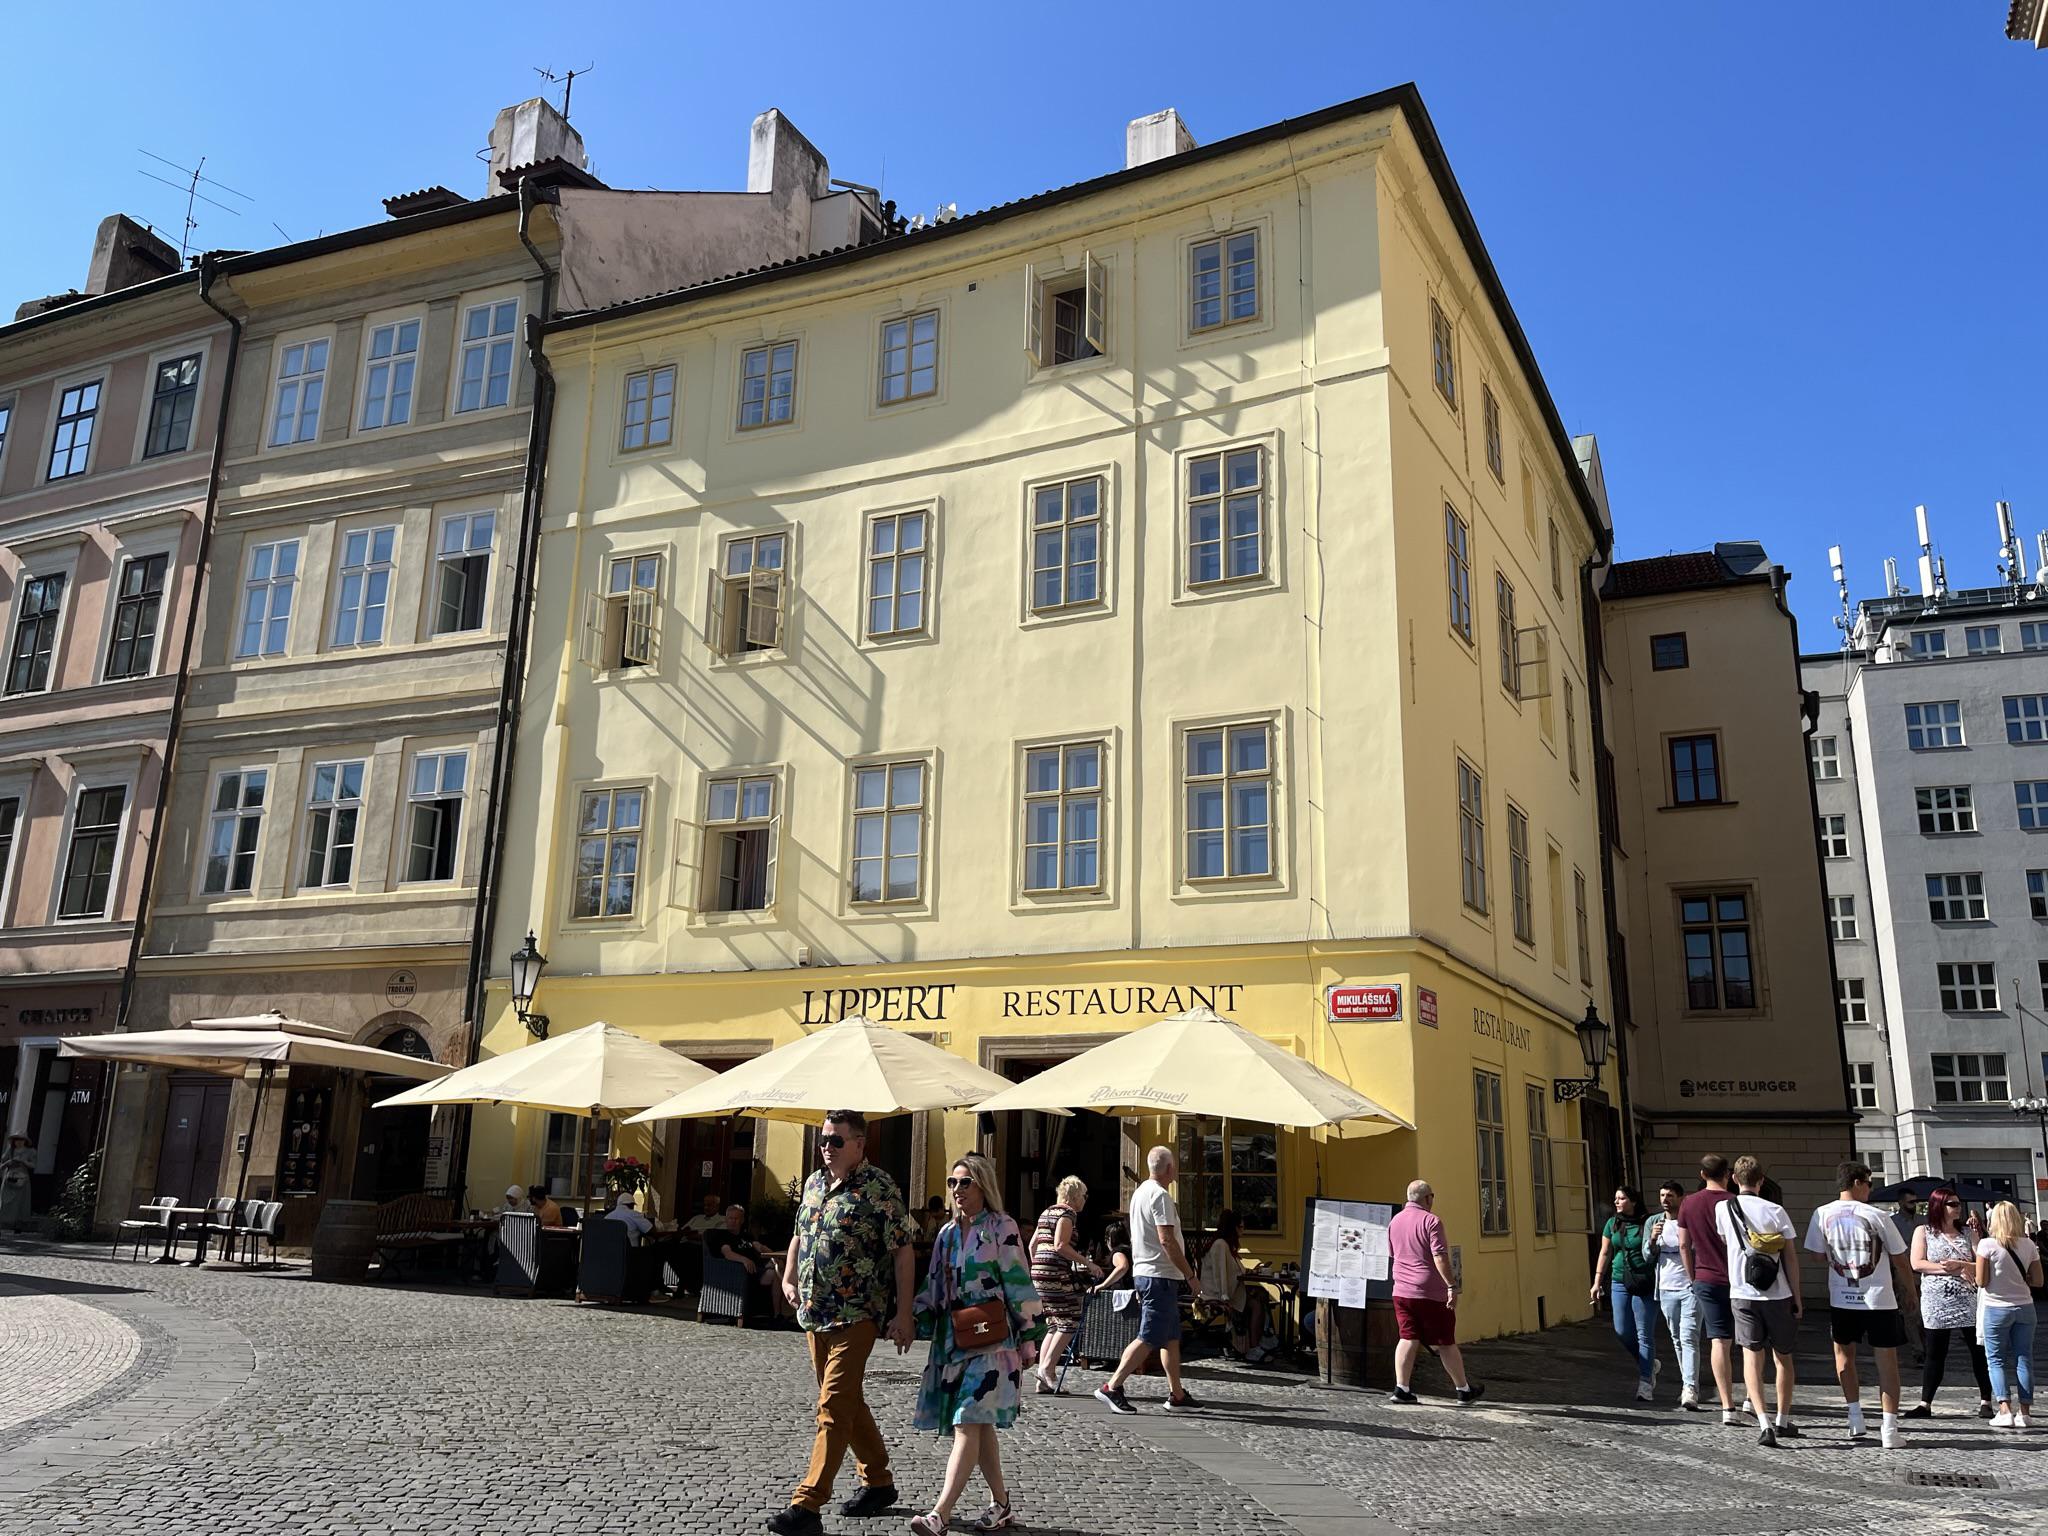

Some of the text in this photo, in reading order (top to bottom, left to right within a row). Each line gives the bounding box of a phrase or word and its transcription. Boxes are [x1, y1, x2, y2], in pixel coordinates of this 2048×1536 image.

[801, 984, 1243, 1024] LIPPERT RESTAURANT
[1336, 992, 1392, 1005] MIKULÁŠSKÁ
[1473, 1008, 1530, 1052] RESTAURANT
[1696, 1080, 1797, 1092] MEET BURGER
[70, 1091, 90, 1103] ATM
[1089, 1085, 1189, 1104] Pilsner Urquell
